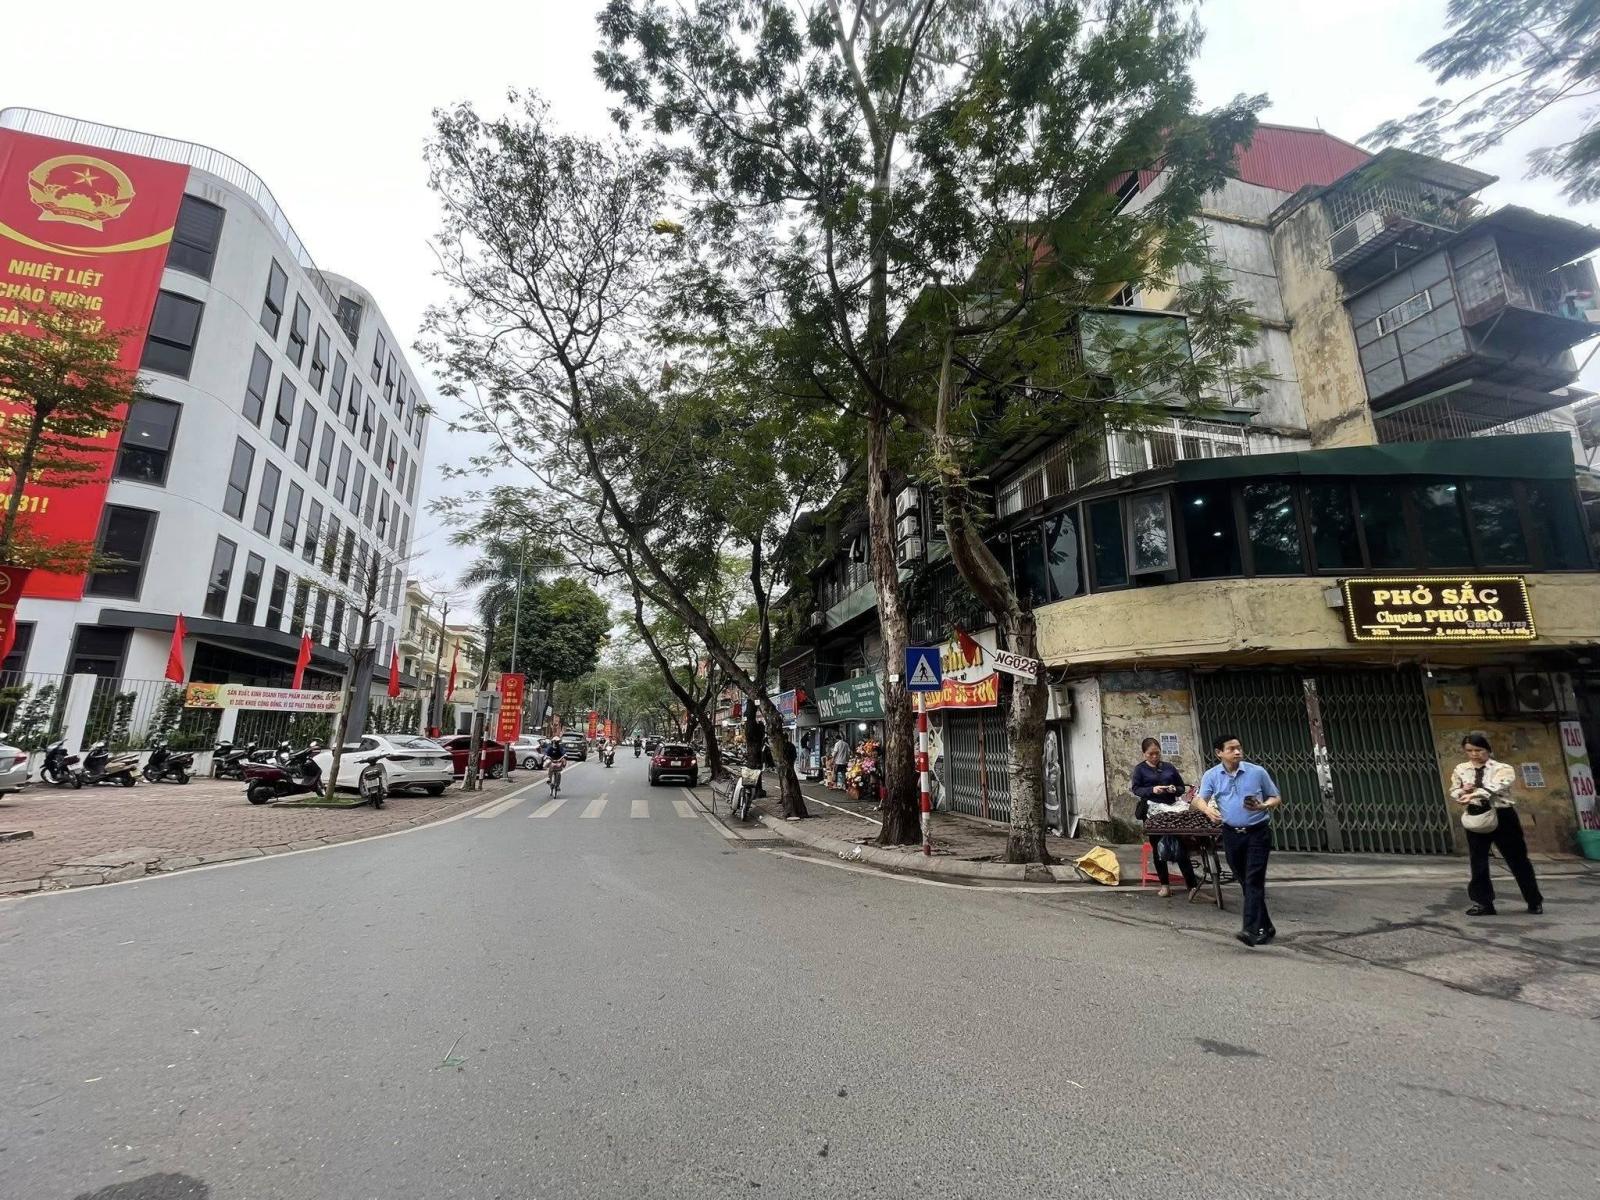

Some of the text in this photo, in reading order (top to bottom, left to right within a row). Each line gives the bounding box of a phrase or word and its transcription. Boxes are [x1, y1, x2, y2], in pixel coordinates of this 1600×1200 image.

[8, 259, 104, 289] NHIỆT LIỆT
[0, 283, 46, 303] CHÀO
[1373, 581, 1499, 605] PHỞ SẮC
[1376, 611, 1422, 625] Chuyên
[1473, 605, 1503, 622] BÒ
